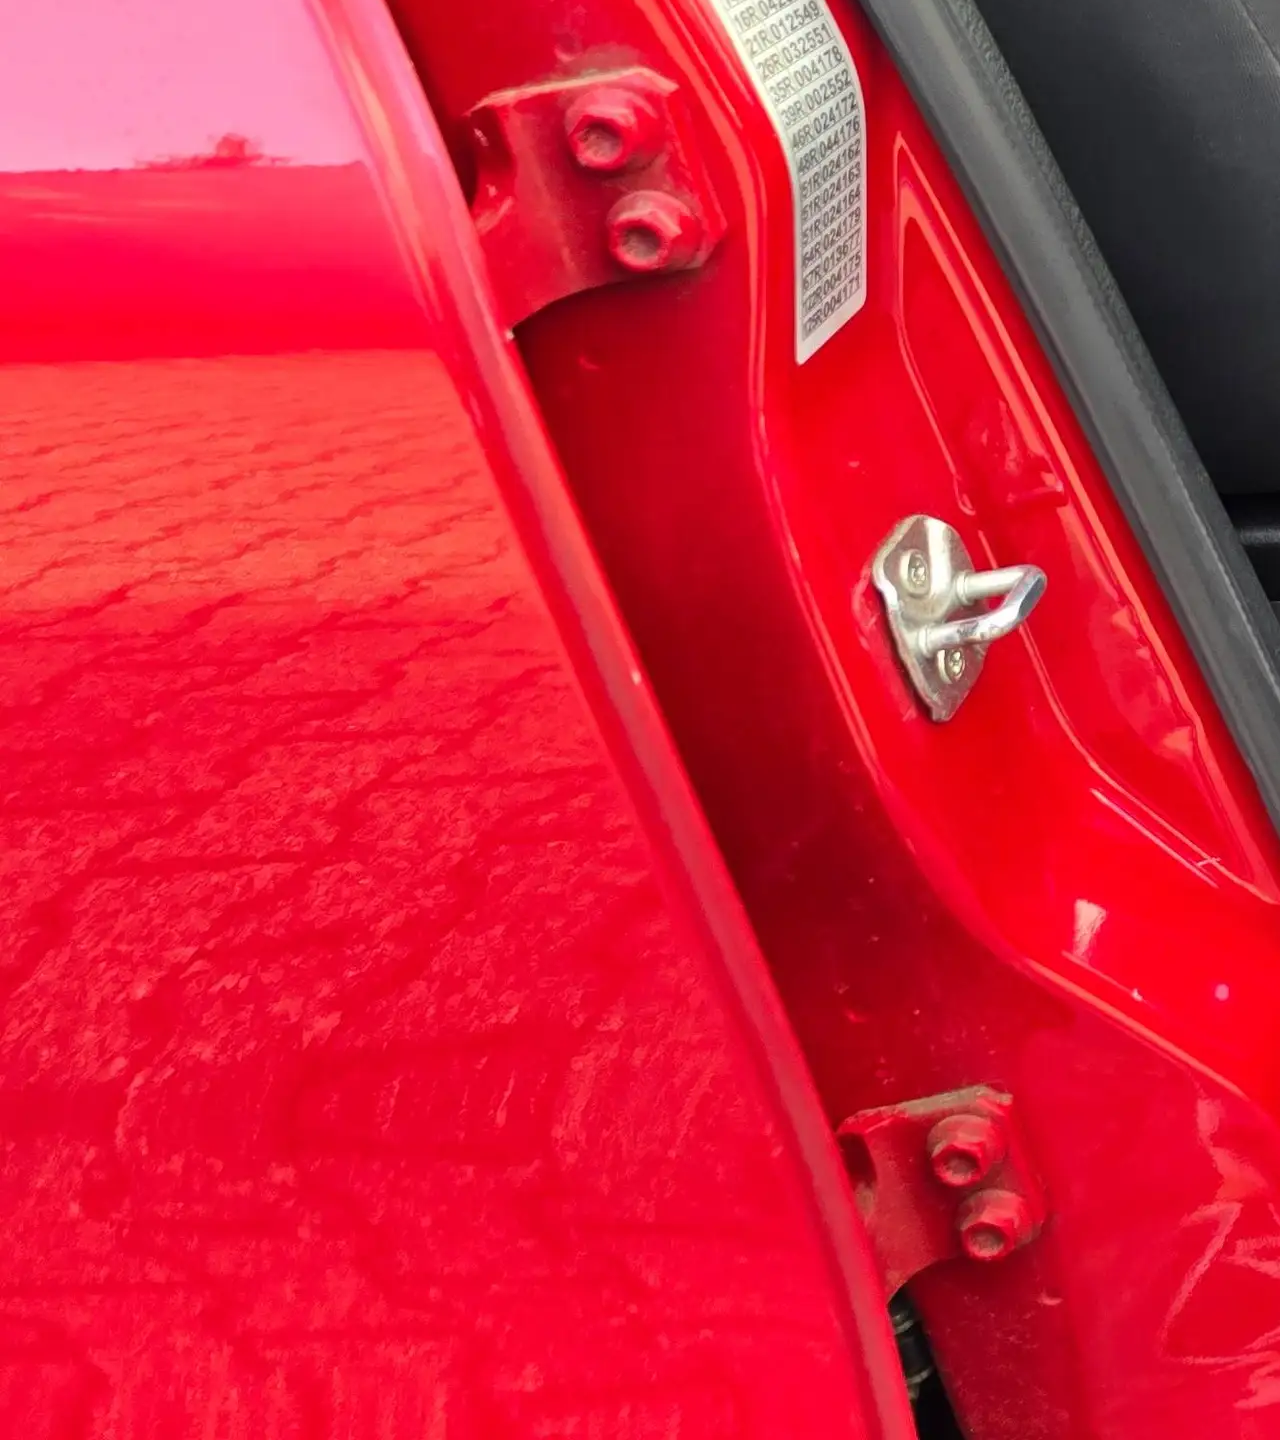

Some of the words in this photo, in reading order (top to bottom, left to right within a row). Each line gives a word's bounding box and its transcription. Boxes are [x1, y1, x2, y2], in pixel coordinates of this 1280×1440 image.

[770, 0, 820, 40] 012549
[781, 23, 831, 62] 032551
[793, 45, 843, 87] 004178
[804, 69, 851, 110] 002552
[813, 92, 857, 134] 024172
